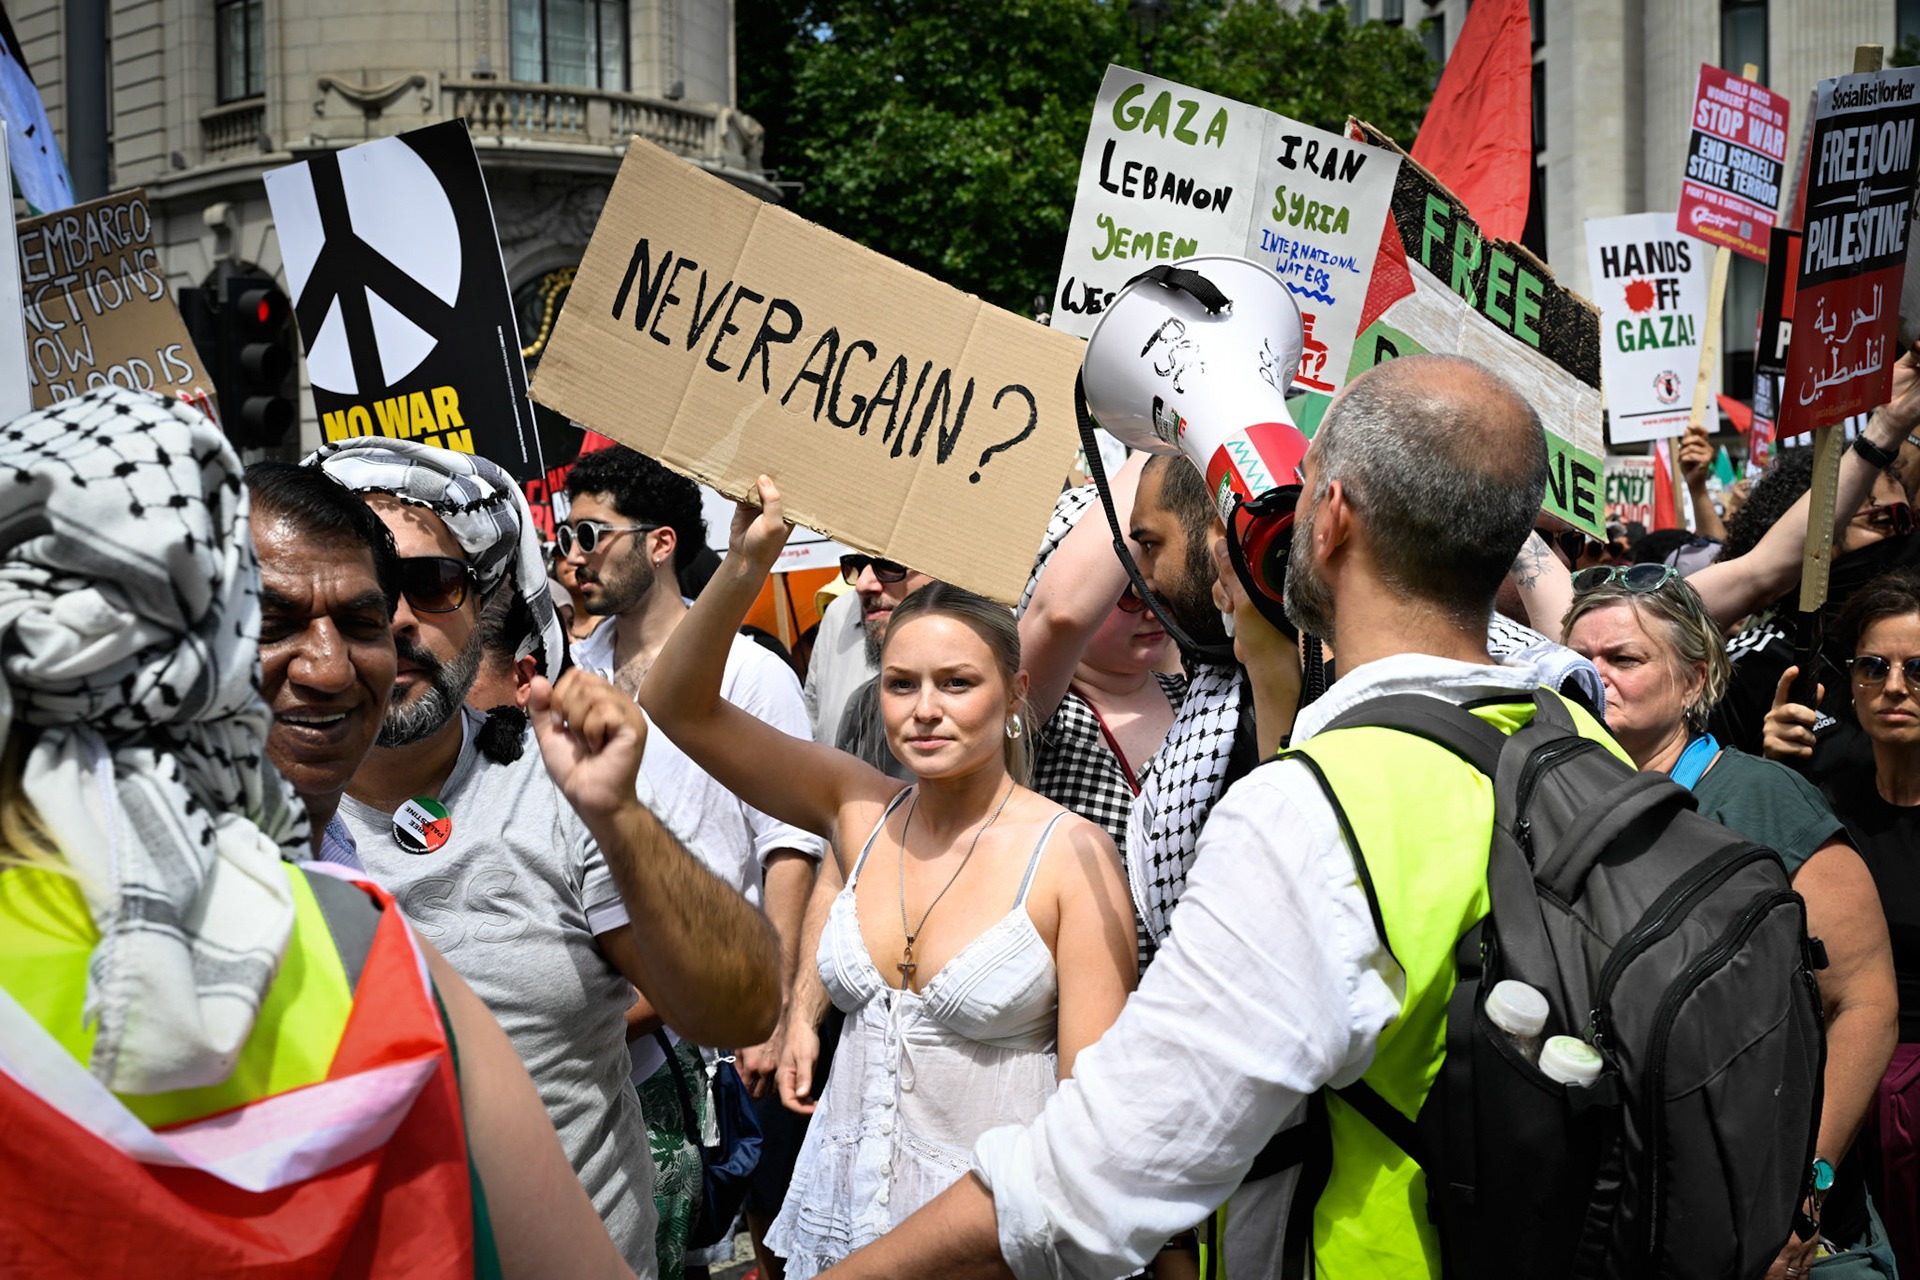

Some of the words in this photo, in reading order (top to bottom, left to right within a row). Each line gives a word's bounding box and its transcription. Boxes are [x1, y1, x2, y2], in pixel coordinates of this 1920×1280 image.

[1112, 83, 1230, 148] GAZA
[1697, 98, 1744, 138] STOP
[1748, 116, 1785, 158] WAR
[1098, 138, 1233, 214] LEBANON
[1276, 134, 1367, 183] IRAN
[1699, 136, 1727, 164] END
[1728, 146, 1775, 182] ISRAELI
[1817, 118, 1915, 187] FREEDOM
[1688, 154, 1730, 187] STATE
[1732, 169, 1778, 207] TERROR
[1271, 184, 1350, 235] SYRIA
[18, 199, 150, 283] EMBARGO
[1091, 213, 1198, 261] YEMEN
[1260, 228, 1360, 274] INTERNATIONAL
[1600, 240, 1691, 279] HANDS
[1805, 201, 1909, 275] PALESTINE
[1276, 257, 1330, 293] WATERS
[1421, 192, 1544, 349] FREE
[1616, 314, 1696, 353] GAZA!
[1814, 283, 1883, 344] الحرية
[156, 344, 195, 385] IS
[611, 238, 803, 395] NEVER
[780, 325, 1038, 485] AGAIN?
[1800, 334, 1885, 406] لفلسطين
[322, 404, 374, 443] NO
[373, 385, 465, 439] WAR
[404, 805, 444, 838] PALESTINE
[408, 819, 429, 837] FREE
